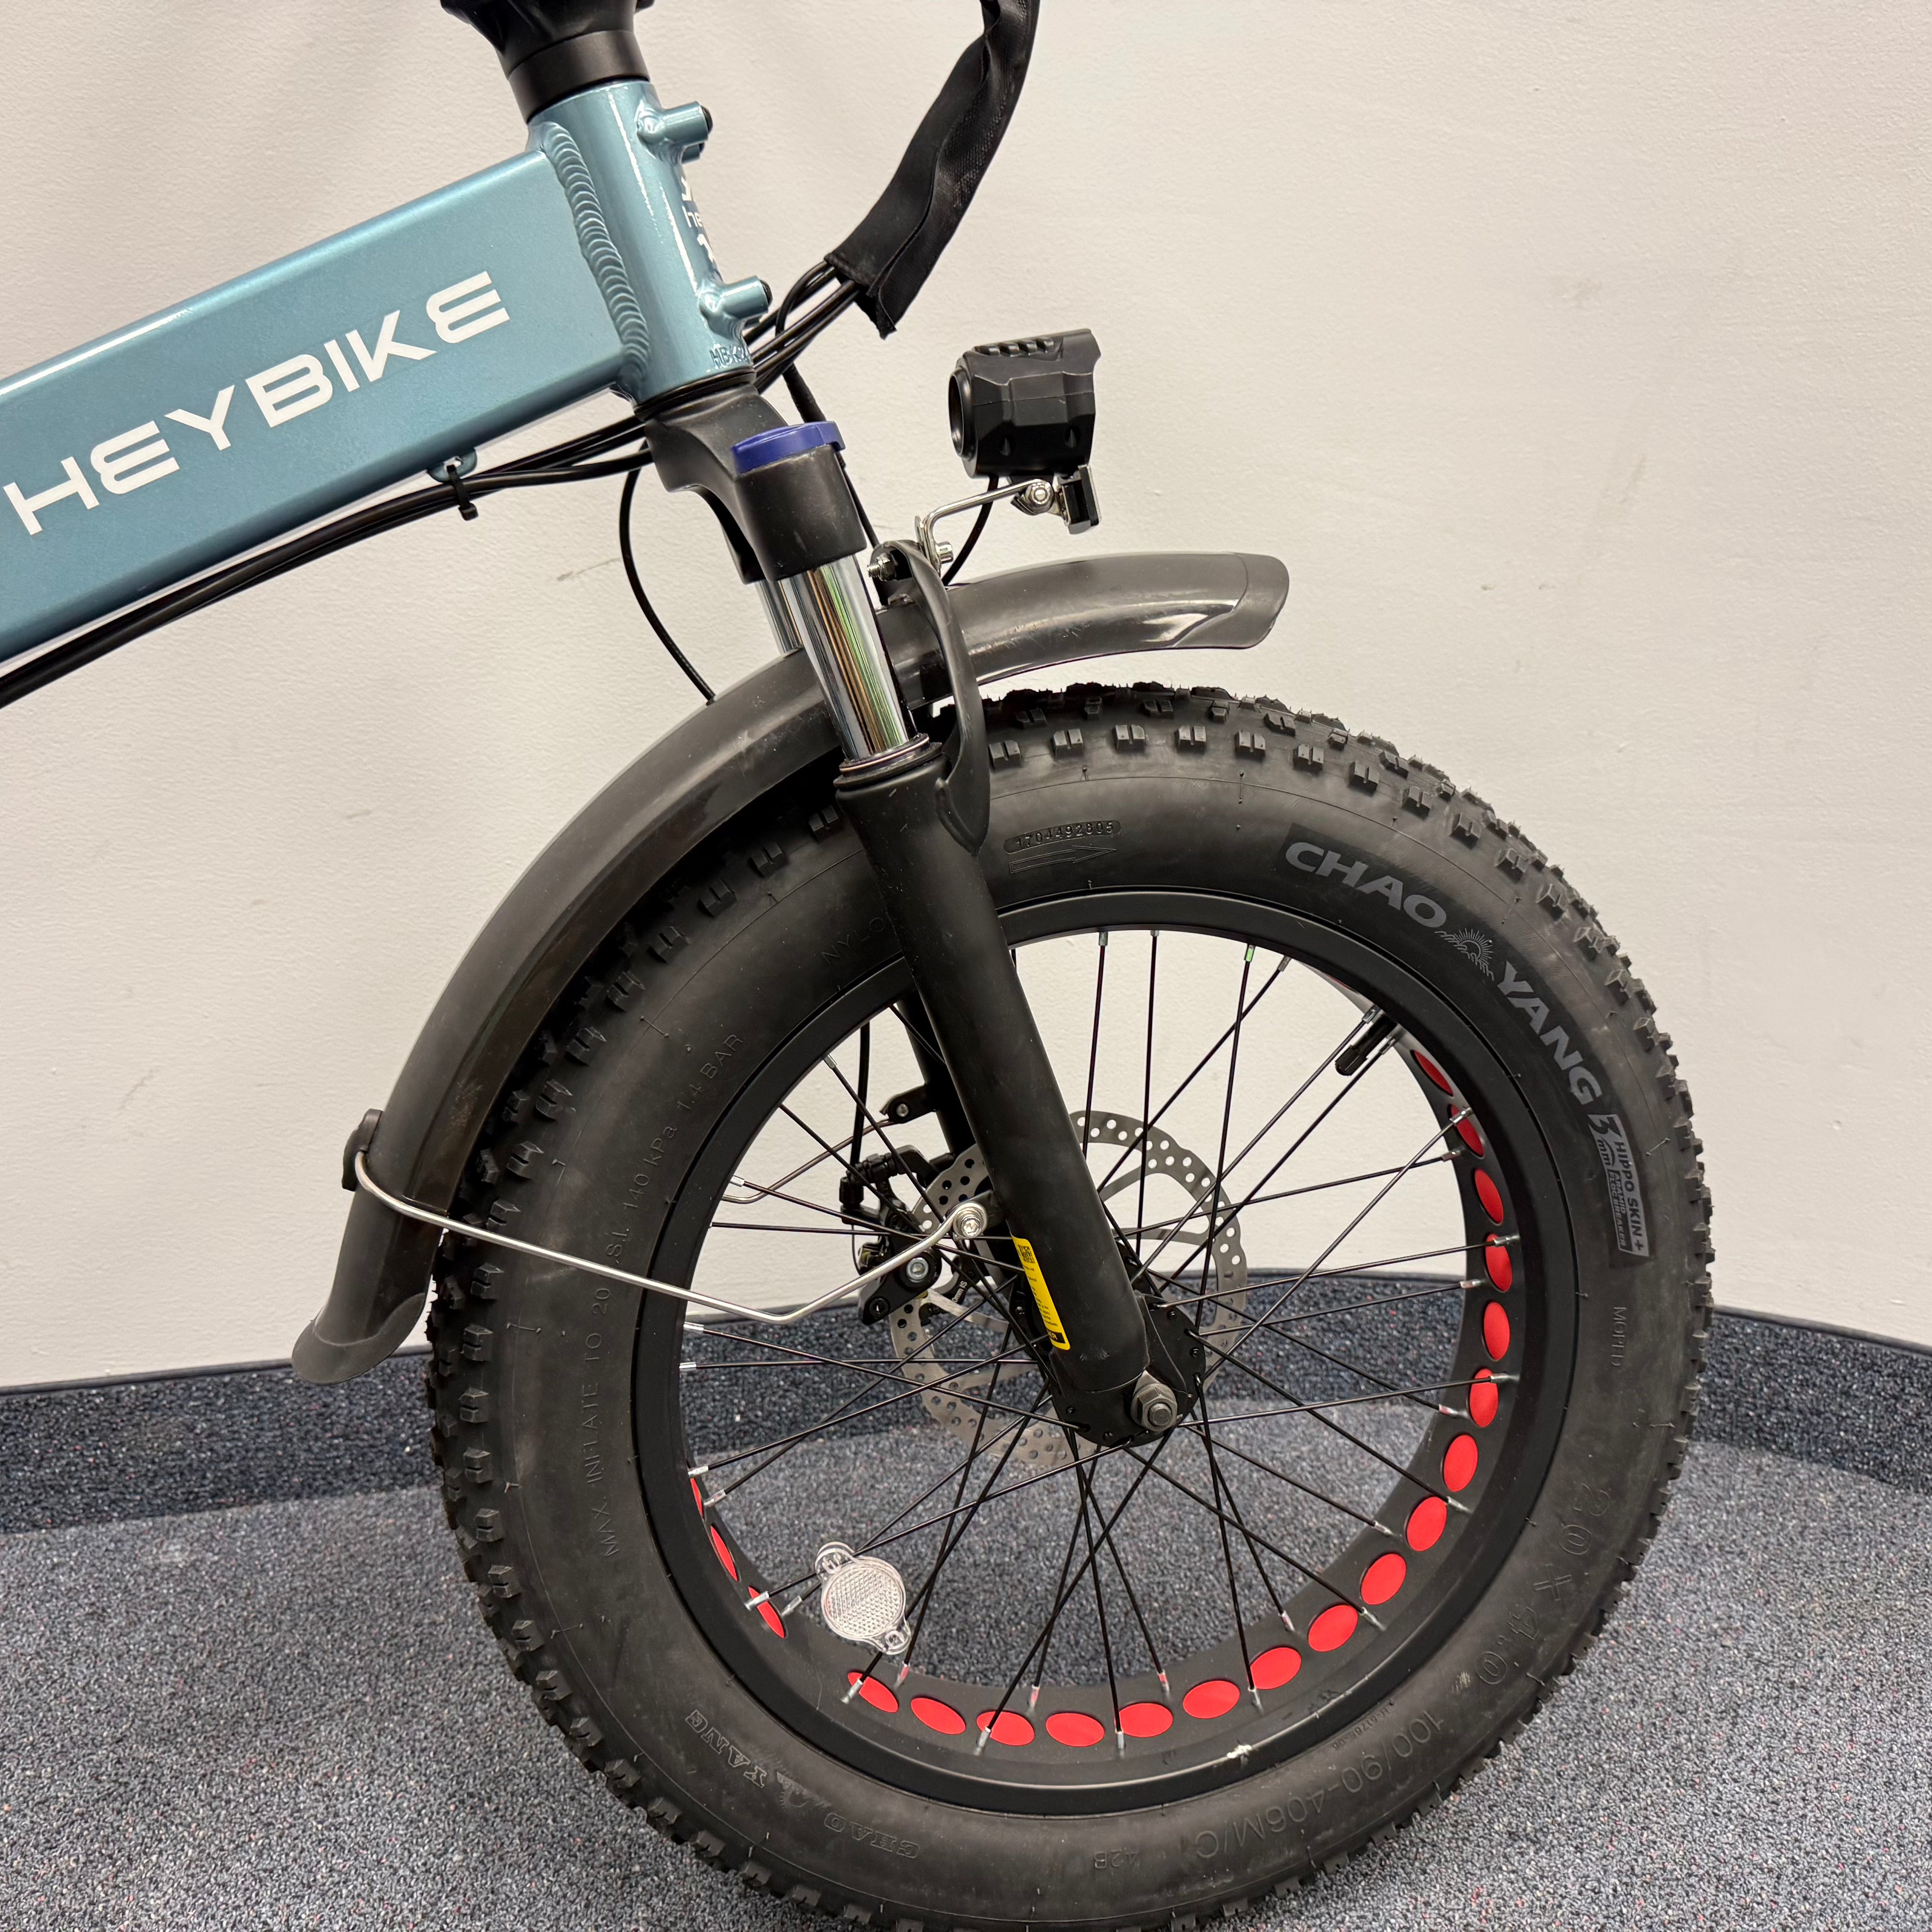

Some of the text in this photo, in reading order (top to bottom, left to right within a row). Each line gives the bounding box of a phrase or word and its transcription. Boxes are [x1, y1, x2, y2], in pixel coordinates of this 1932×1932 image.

[4, 270, 510, 535] HEYBIKE
[1285, 842, 1603, 1105] CHAO YANG
[698, 1030, 745, 1081] BAR
[674, 1077, 708, 1114] 1.4
[642, 1120, 679, 1167] kPa
[621, 1170, 652, 1213] 140
[590, 1285, 612, 1315] 20
[584, 1332, 603, 1362] TO
[683, 1707, 921, 1860] CHAO YANG
[1093, 1845, 1139, 1869] 42B
